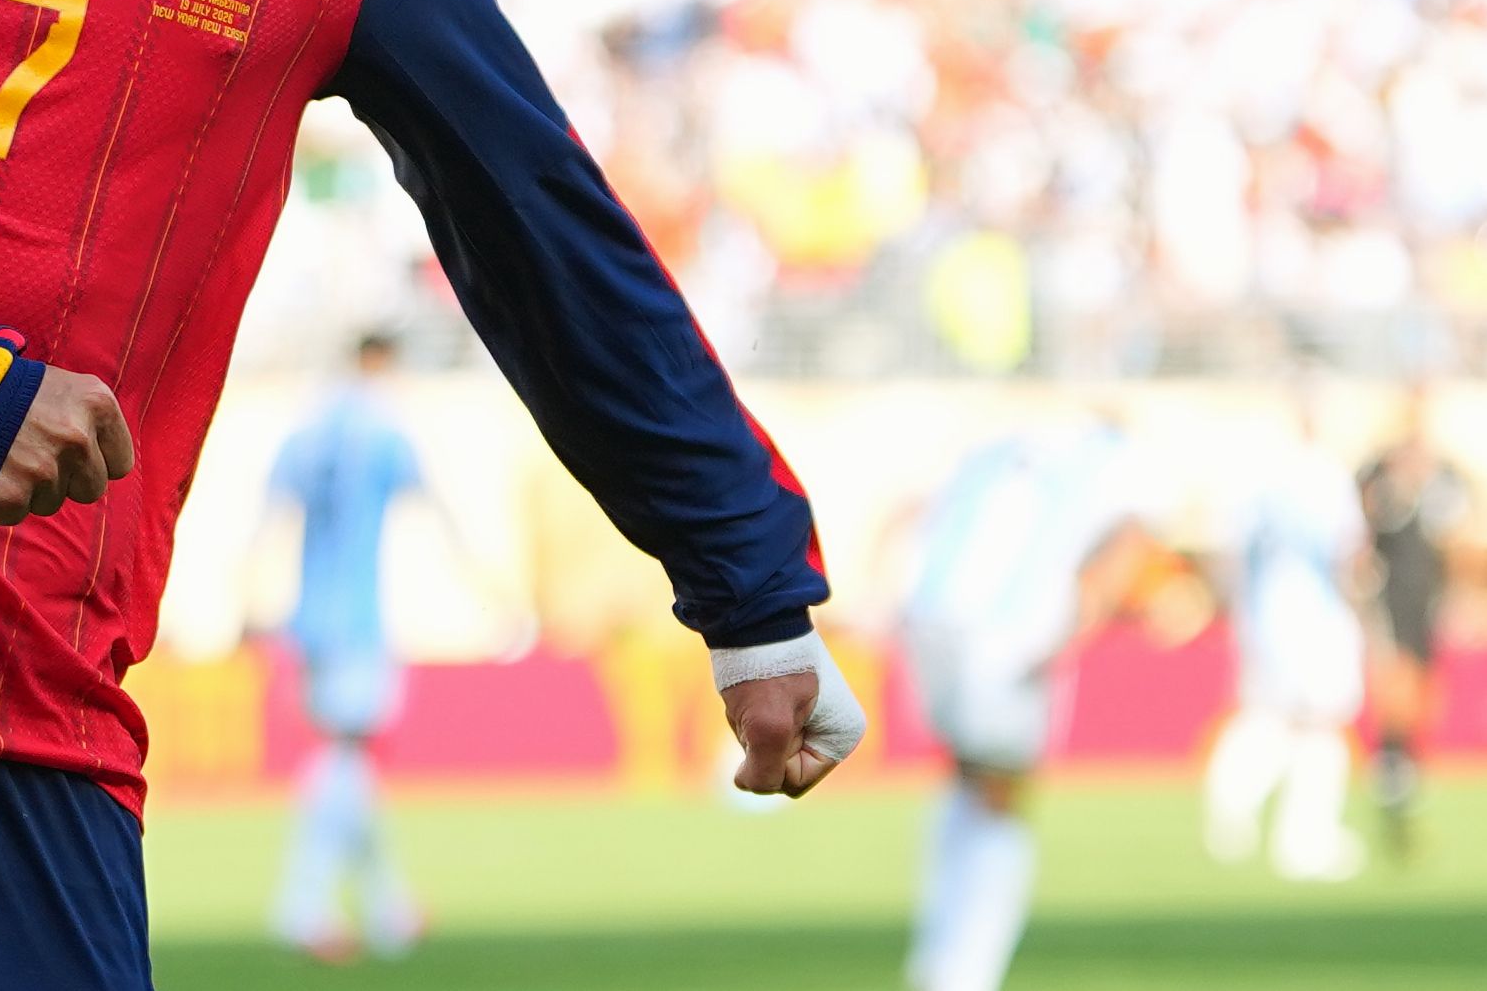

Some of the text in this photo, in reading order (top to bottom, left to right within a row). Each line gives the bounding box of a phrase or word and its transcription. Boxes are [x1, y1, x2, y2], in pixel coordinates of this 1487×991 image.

[153, 2, 174, 20] NEW
[177, 11, 199, 27] YORK
[201, 19, 222, 35] NEW
[191, 2, 211, 16] JULY
[212, 8, 234, 25] 2026
